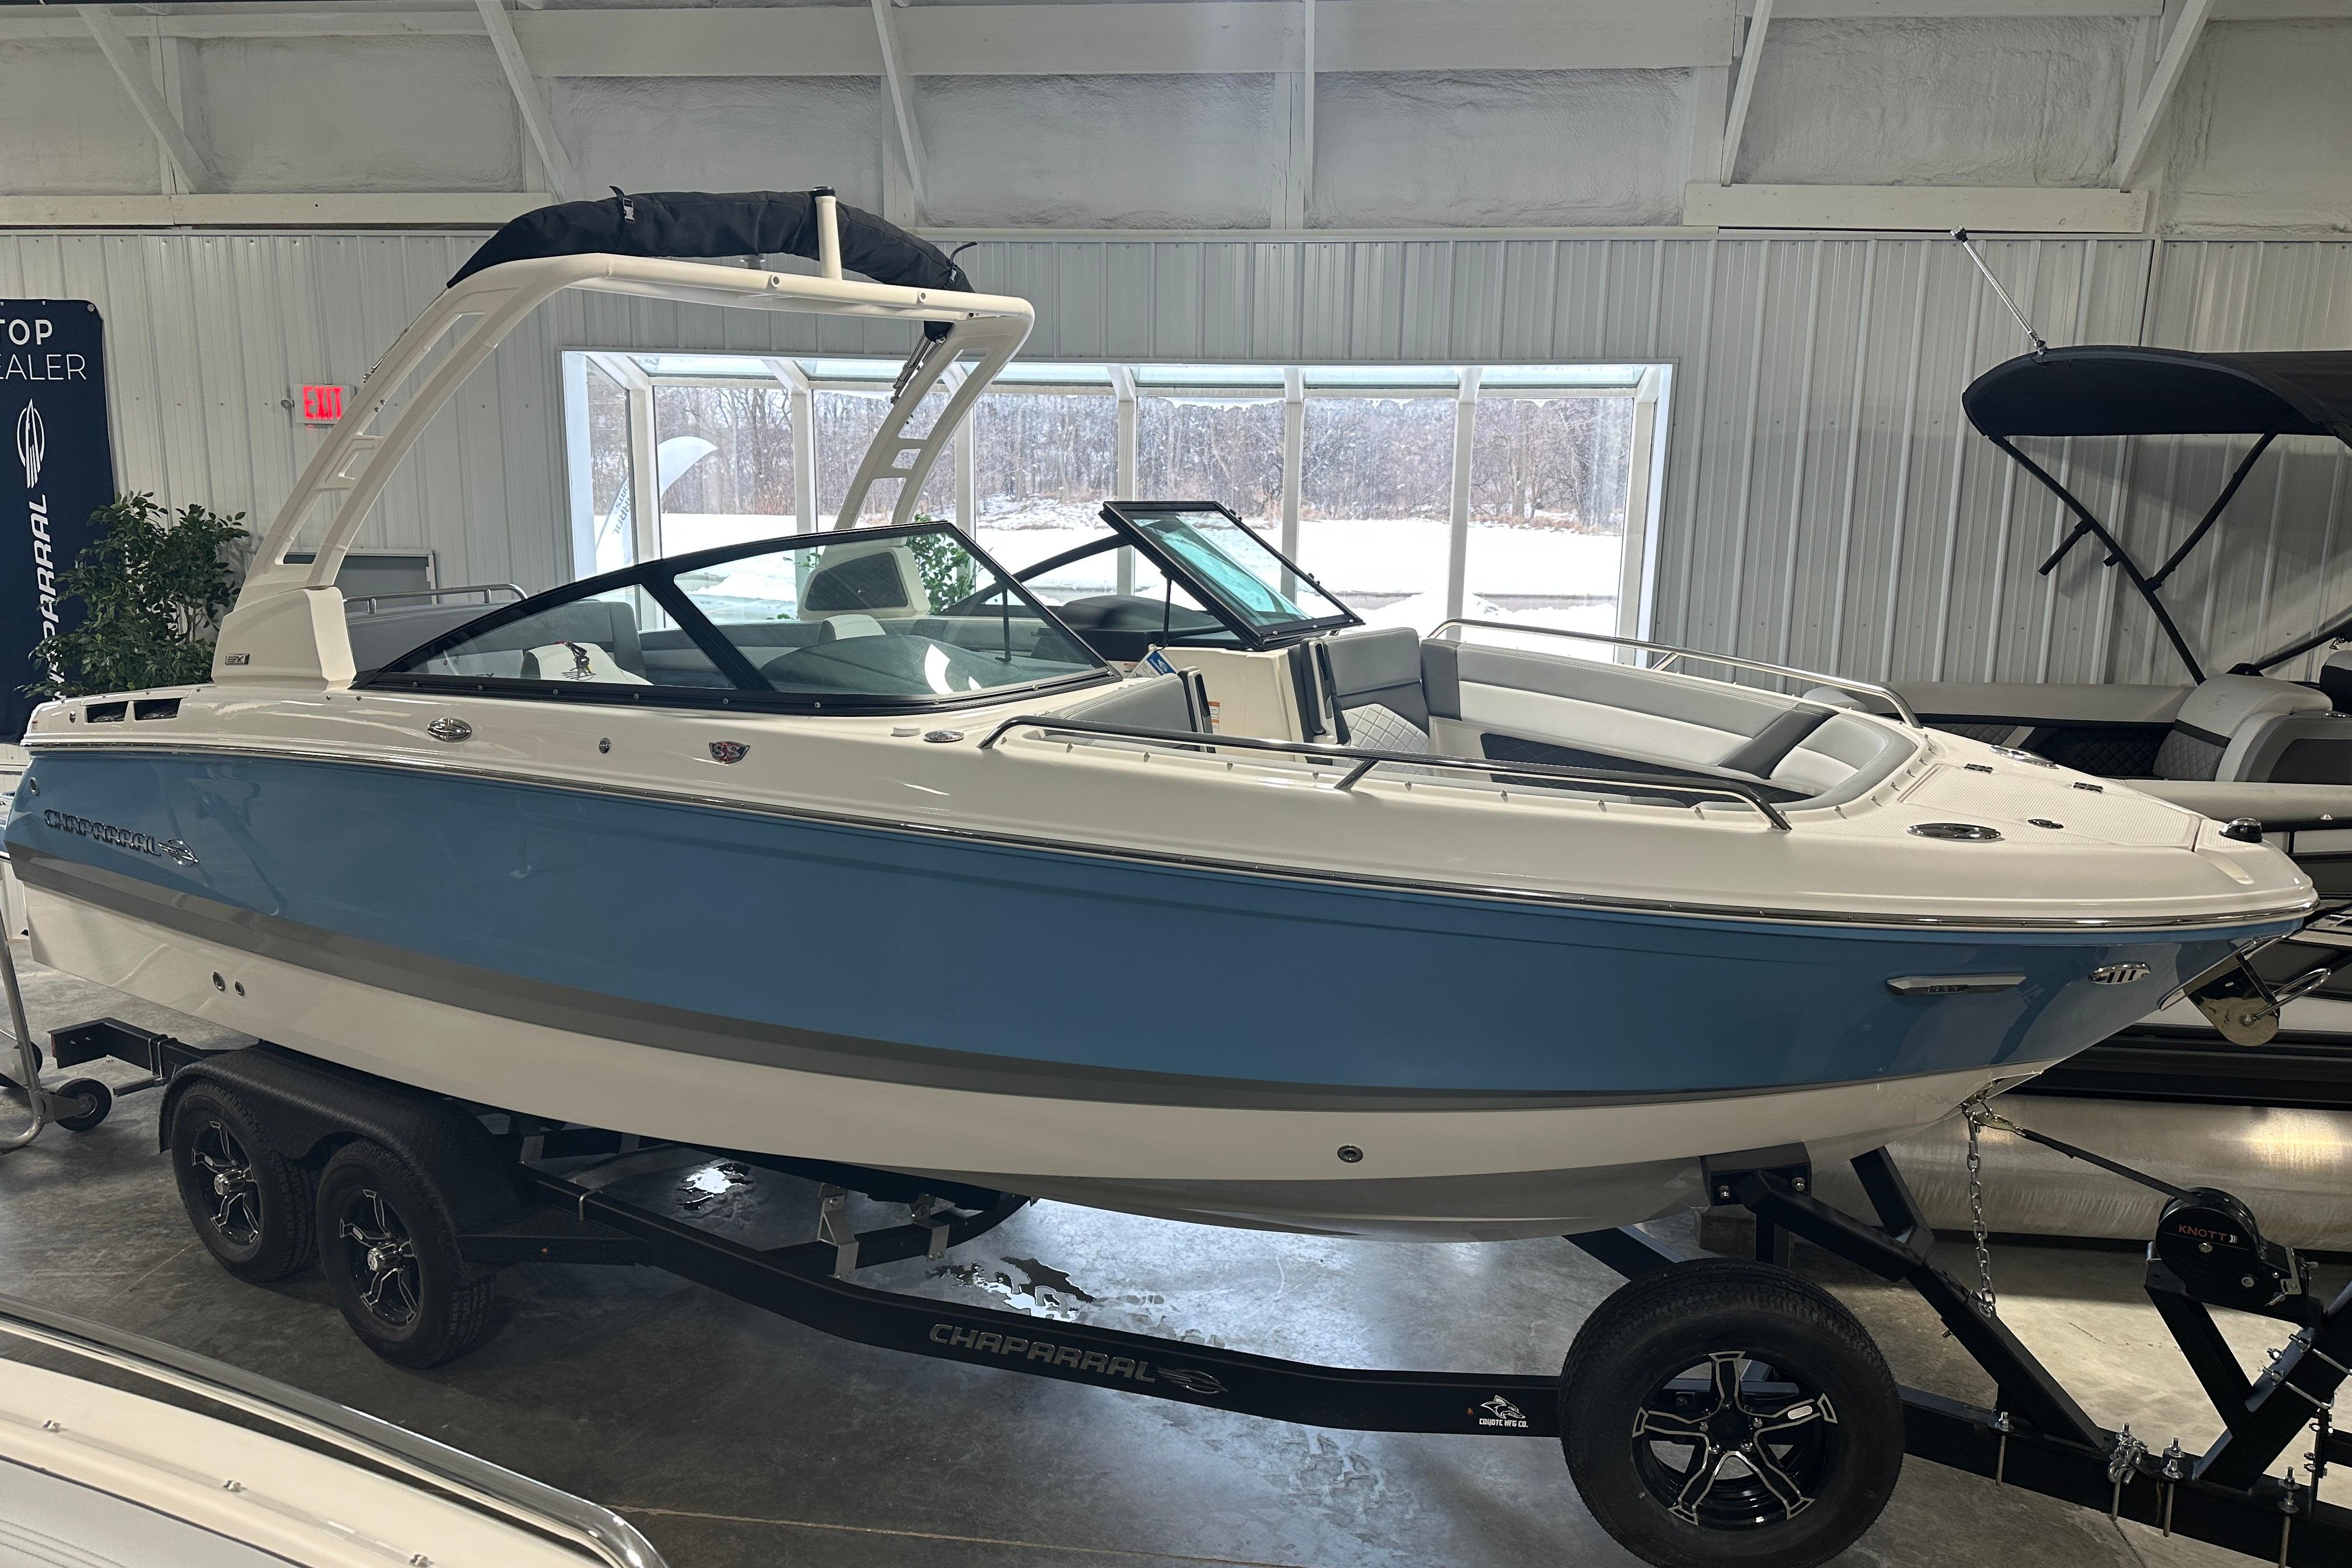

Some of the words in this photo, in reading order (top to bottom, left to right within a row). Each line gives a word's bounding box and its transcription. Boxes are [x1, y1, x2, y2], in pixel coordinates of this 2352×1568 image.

[0, 319, 53, 345] OP
[303, 386, 343, 420] EXIT
[44, 809, 162, 857] CHAPARRAL
[2178, 1224, 2228, 1241] KNOTT
[929, 1324, 1156, 1383] CHAPARRAL
[1479, 1418, 1503, 1427] COYOTE
[1504, 1419, 1517, 1427] MFG
